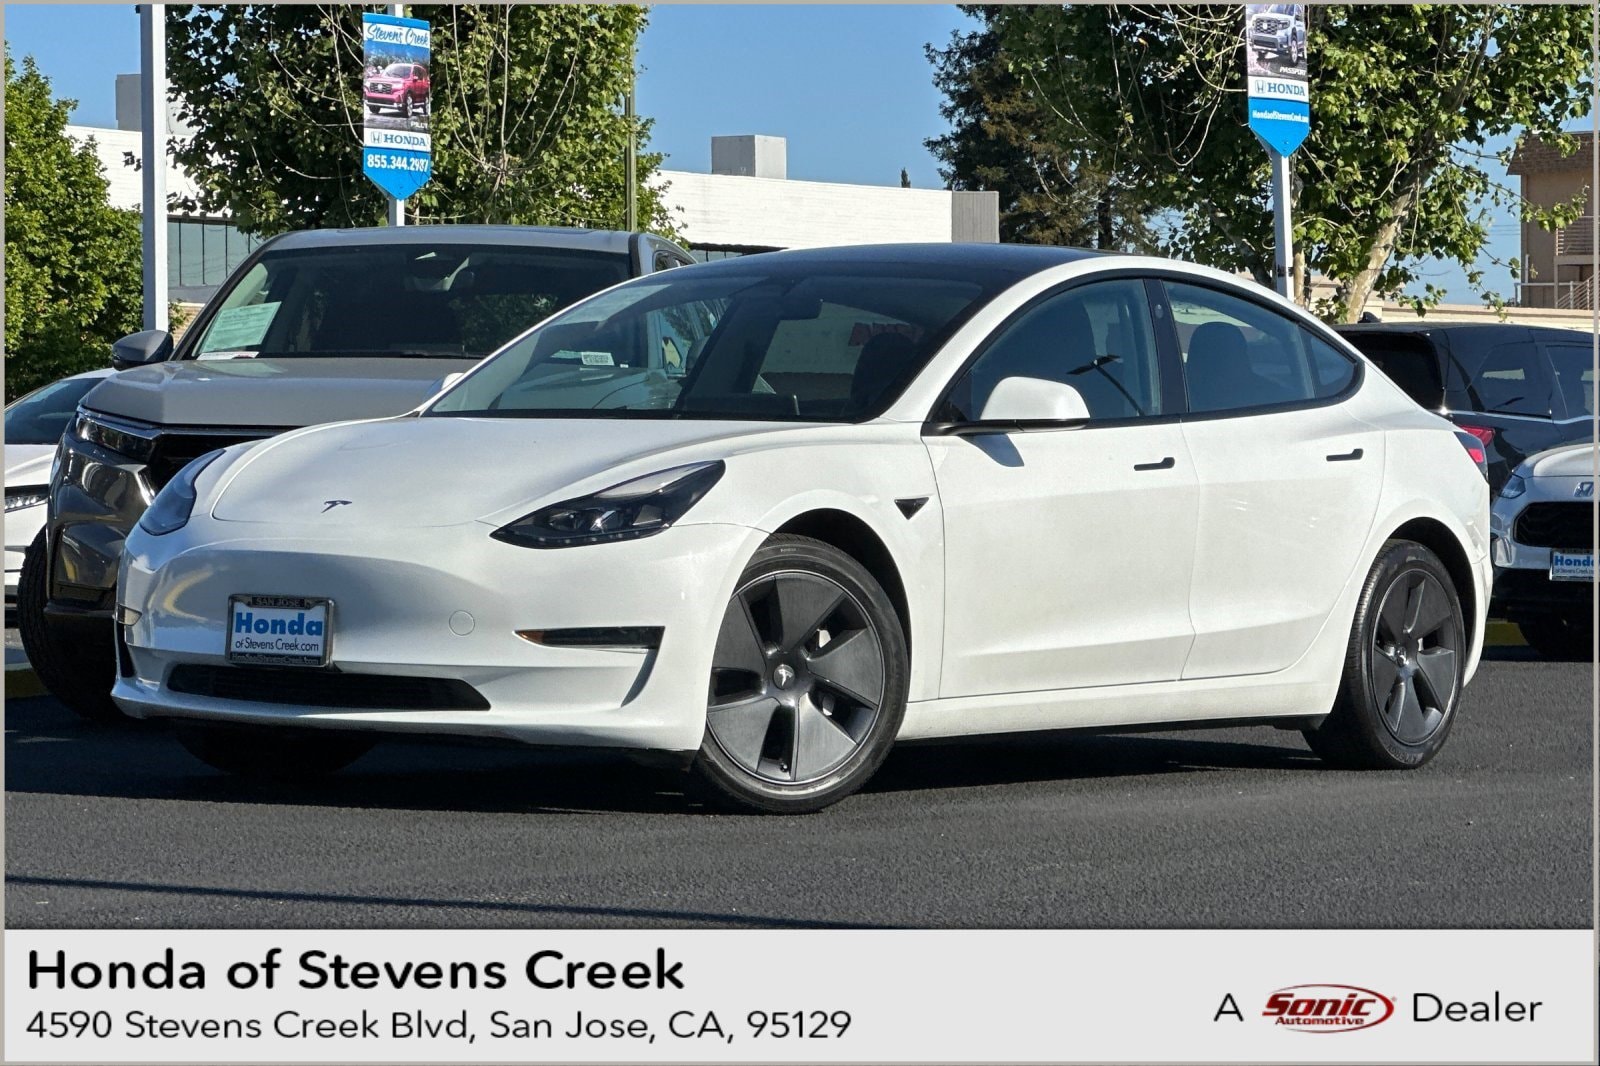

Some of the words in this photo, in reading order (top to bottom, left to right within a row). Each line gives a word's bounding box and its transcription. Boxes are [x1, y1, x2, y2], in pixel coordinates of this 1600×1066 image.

[366, 23, 403, 44] Stevens
[405, 28, 429, 46] Creek
[1267, 82, 1306, 97] HONDA
[383, 133, 427, 147] HONDA
[255, 597, 275, 606] SAN
[277, 598, 301, 608] JOSE
[234, 612, 323, 637] Honda
[235, 640, 244, 649] of
[245, 637, 275, 650] Stevens
[275, 638, 319, 651] Creek.com
